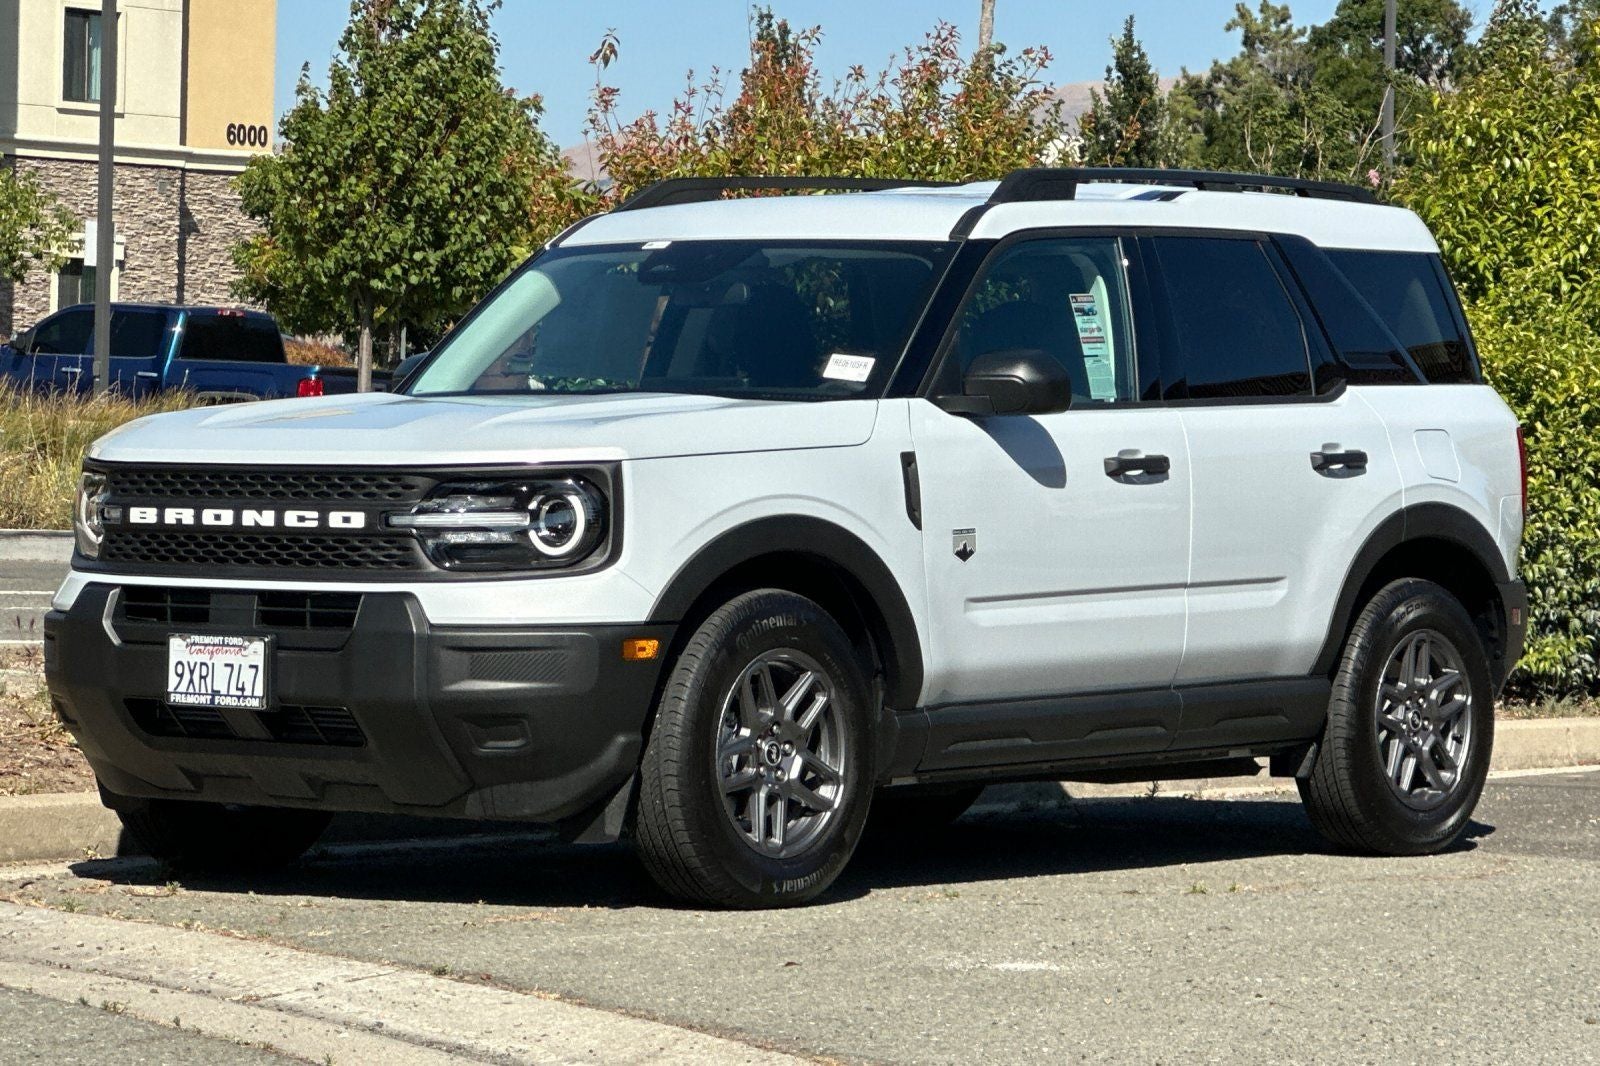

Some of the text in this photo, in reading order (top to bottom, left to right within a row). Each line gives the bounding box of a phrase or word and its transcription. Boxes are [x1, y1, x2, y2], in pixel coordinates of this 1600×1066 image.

[226, 122, 268, 148] 6000
[129, 506, 366, 529] BRONCO
[190, 635, 243, 646] FREMONT FORD
[187, 644, 249, 660] California
[173, 660, 260, 696] 9XRL747
[170, 693, 260, 707] FREMONT FORD.COM
